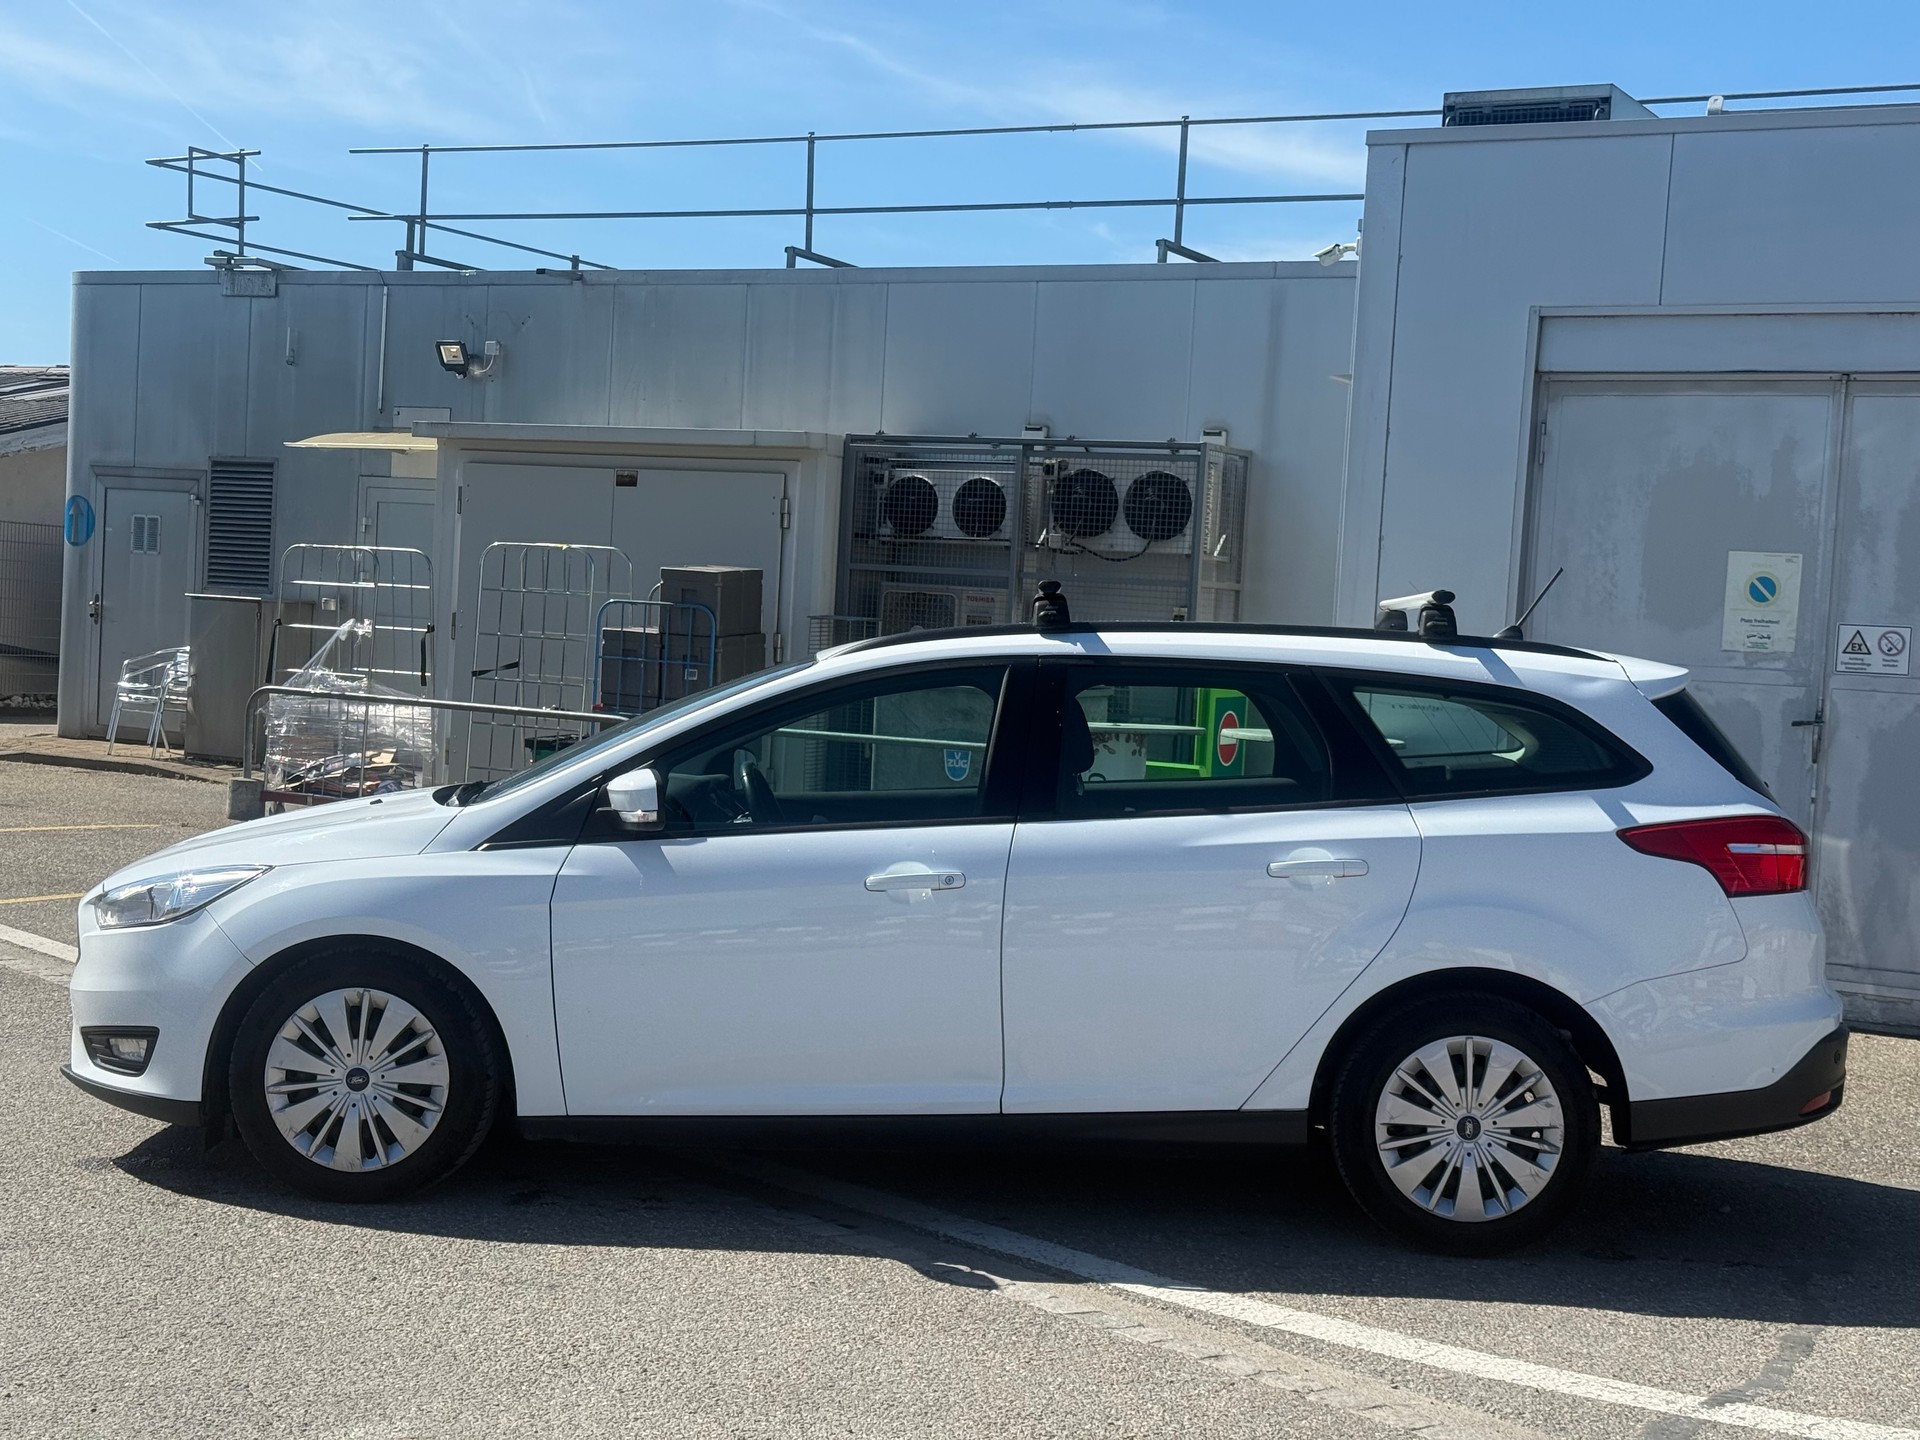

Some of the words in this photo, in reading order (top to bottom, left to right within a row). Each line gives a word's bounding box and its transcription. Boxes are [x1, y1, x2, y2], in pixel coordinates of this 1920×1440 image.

[966, 595, 995, 603] TOSHIBA
[1851, 643, 1863, 652] EX
[954, 752, 961, 760] V
[947, 759, 968, 768] ZUG
